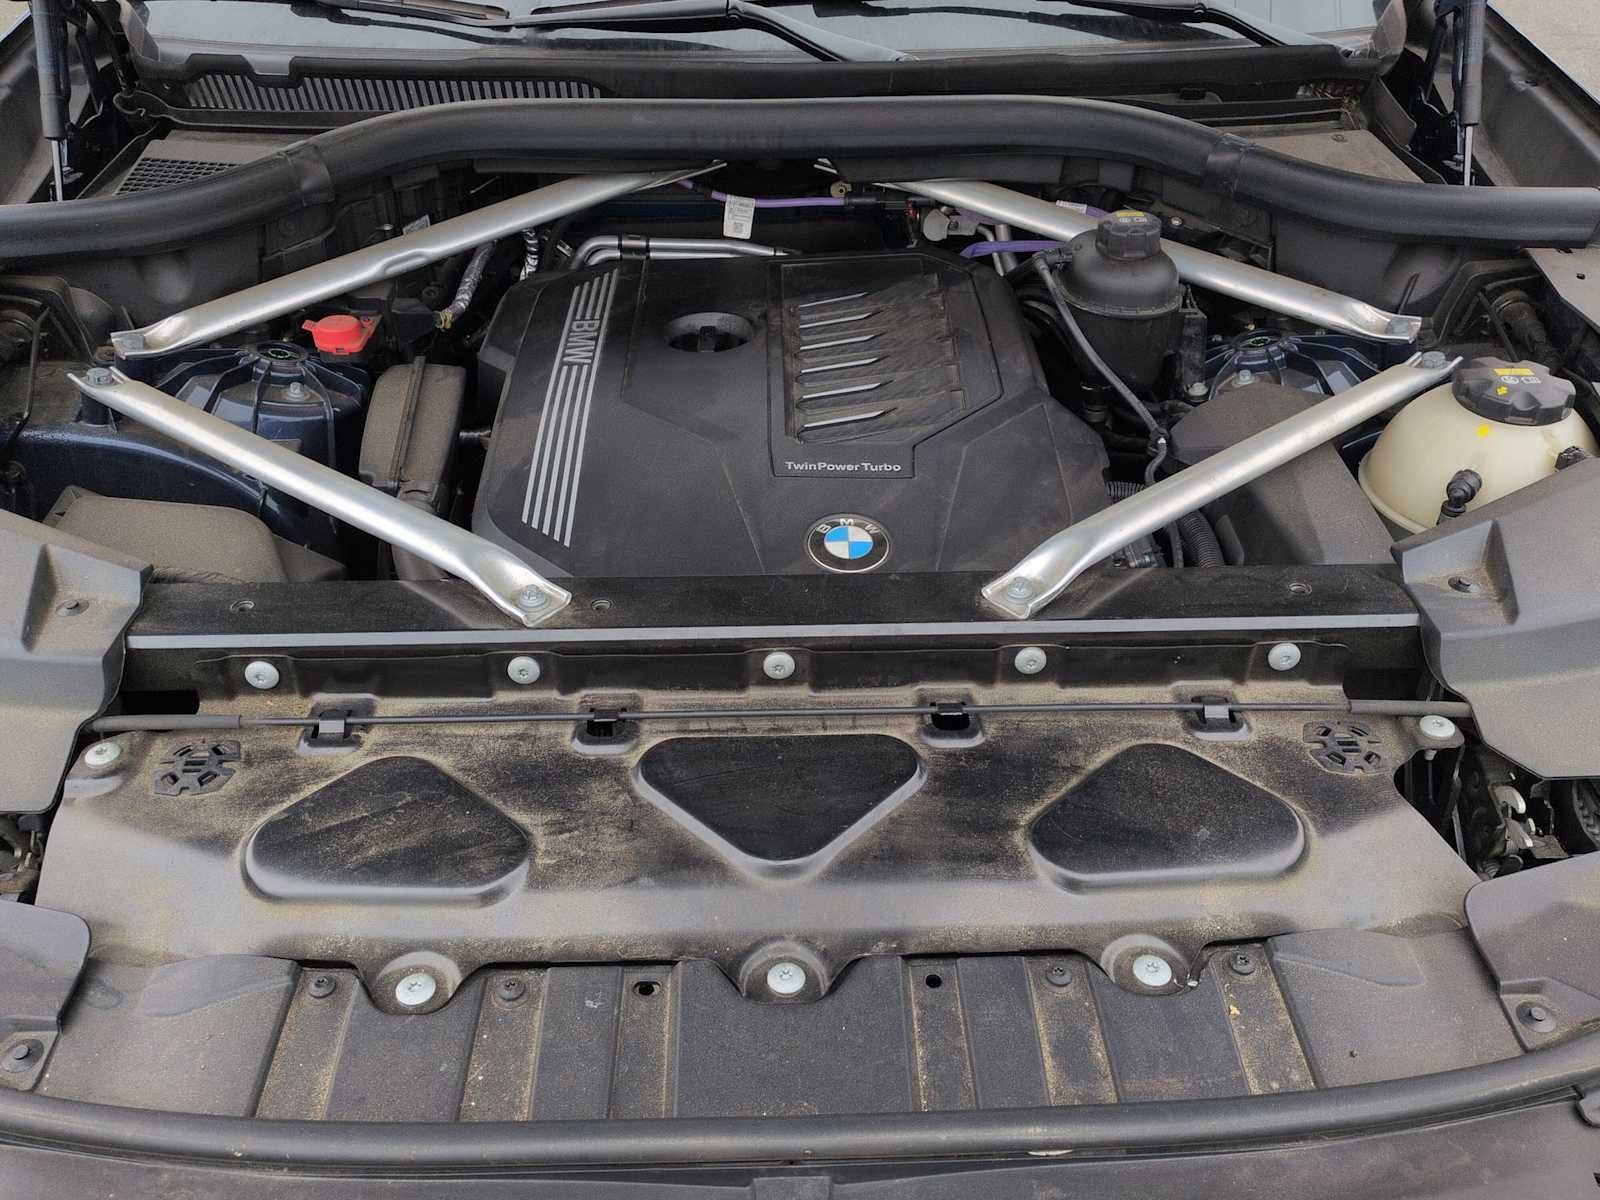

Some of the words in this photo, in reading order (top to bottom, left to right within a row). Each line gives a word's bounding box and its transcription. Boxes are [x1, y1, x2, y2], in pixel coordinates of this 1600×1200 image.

[563, 320, 600, 363] BMW
[861, 462, 902, 472] Turbo
[815, 518, 882, 535] BMW
